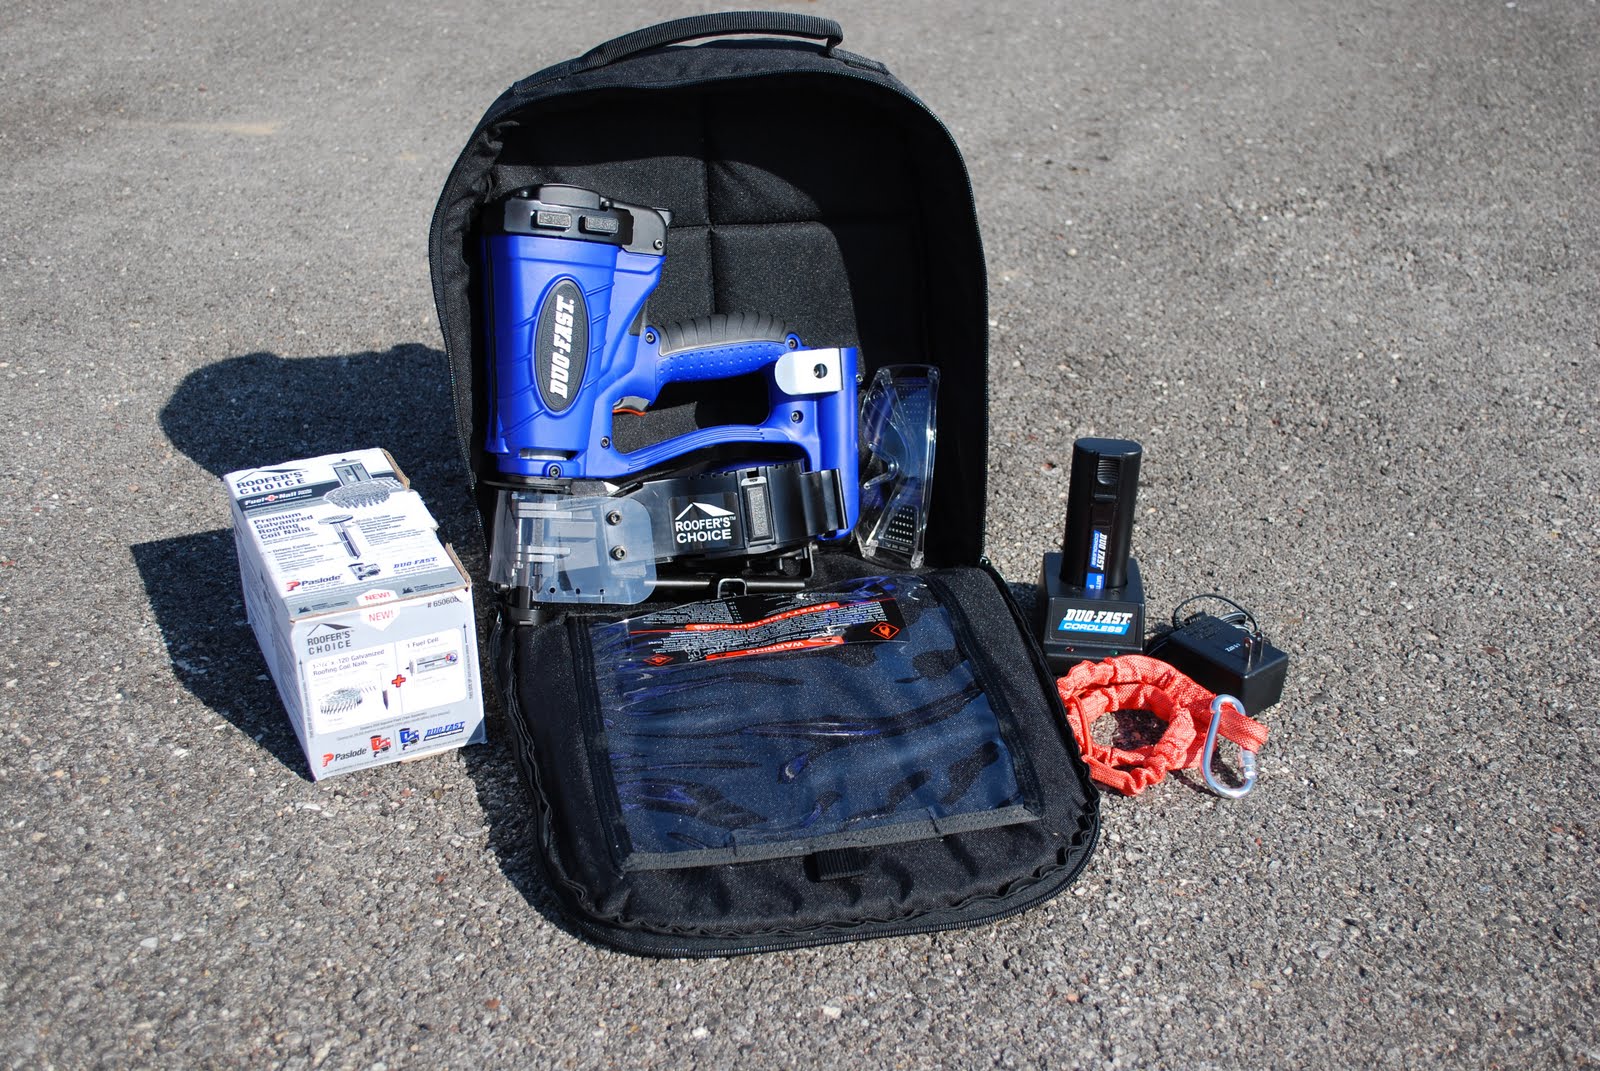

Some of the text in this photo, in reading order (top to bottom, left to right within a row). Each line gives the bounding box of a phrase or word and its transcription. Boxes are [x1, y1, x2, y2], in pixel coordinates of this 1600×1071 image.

[236, 471, 303, 488] ROOFER'S
[239, 478, 306, 494] CHOICE
[245, 497, 265, 506] Fuel
[254, 512, 301, 524] Premium
[256, 515, 314, 529] Galvanized
[675, 517, 731, 532] ROOFER'S
[258, 523, 299, 534] Roofing
[260, 531, 280, 539] Coil
[283, 526, 310, 535] Nails
[676, 528, 732, 544] CHOICE
[301, 575, 341, 586] Paslode
[365, 592, 391, 601] NEW!
[368, 609, 393, 622] NEW!
[693, 603, 831, 630] SAFETY INSTRUCTIONS
[1063, 622, 1123, 633] CORDLESS
[307, 630, 351, 646] ROOFER'S
[412, 640, 426, 648] Fuel
[308, 640, 352, 655] CHOICE
[746, 642, 804, 654] WARNING
[351, 649, 385, 661] Galvanized
[313, 667, 338, 676] Roofing
[352, 660, 368, 668] Nails
[334, 747, 367, 762] Paslode
